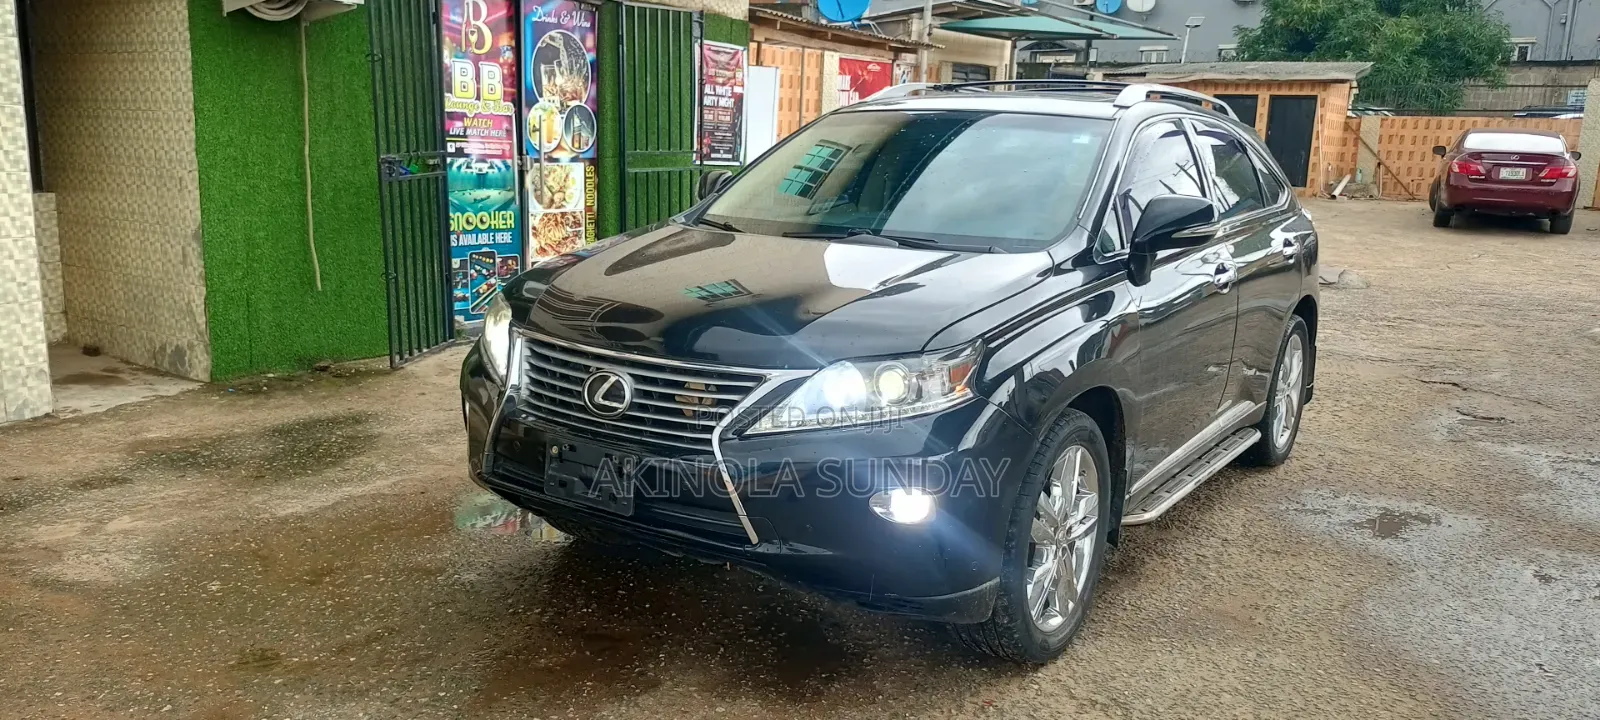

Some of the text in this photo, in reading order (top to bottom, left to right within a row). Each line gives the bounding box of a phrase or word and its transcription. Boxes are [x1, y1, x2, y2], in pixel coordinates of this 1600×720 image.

[532, 5, 558, 23] Drinks
[560, 10, 570, 24] &
[704, 84, 715, 94] ALL
[446, 95, 480, 116] Lounge
[492, 100, 513, 115] Bar
[703, 95, 718, 107] ARTY
[464, 117, 493, 128] WATCH
[449, 127, 506, 138] LIVE MATCH HERE
[586, 165, 596, 247] PAGHETTI NOODLES
[450, 210, 515, 231] SNOOKER
[450, 231, 513, 247] IS AVAILABLE HERE
